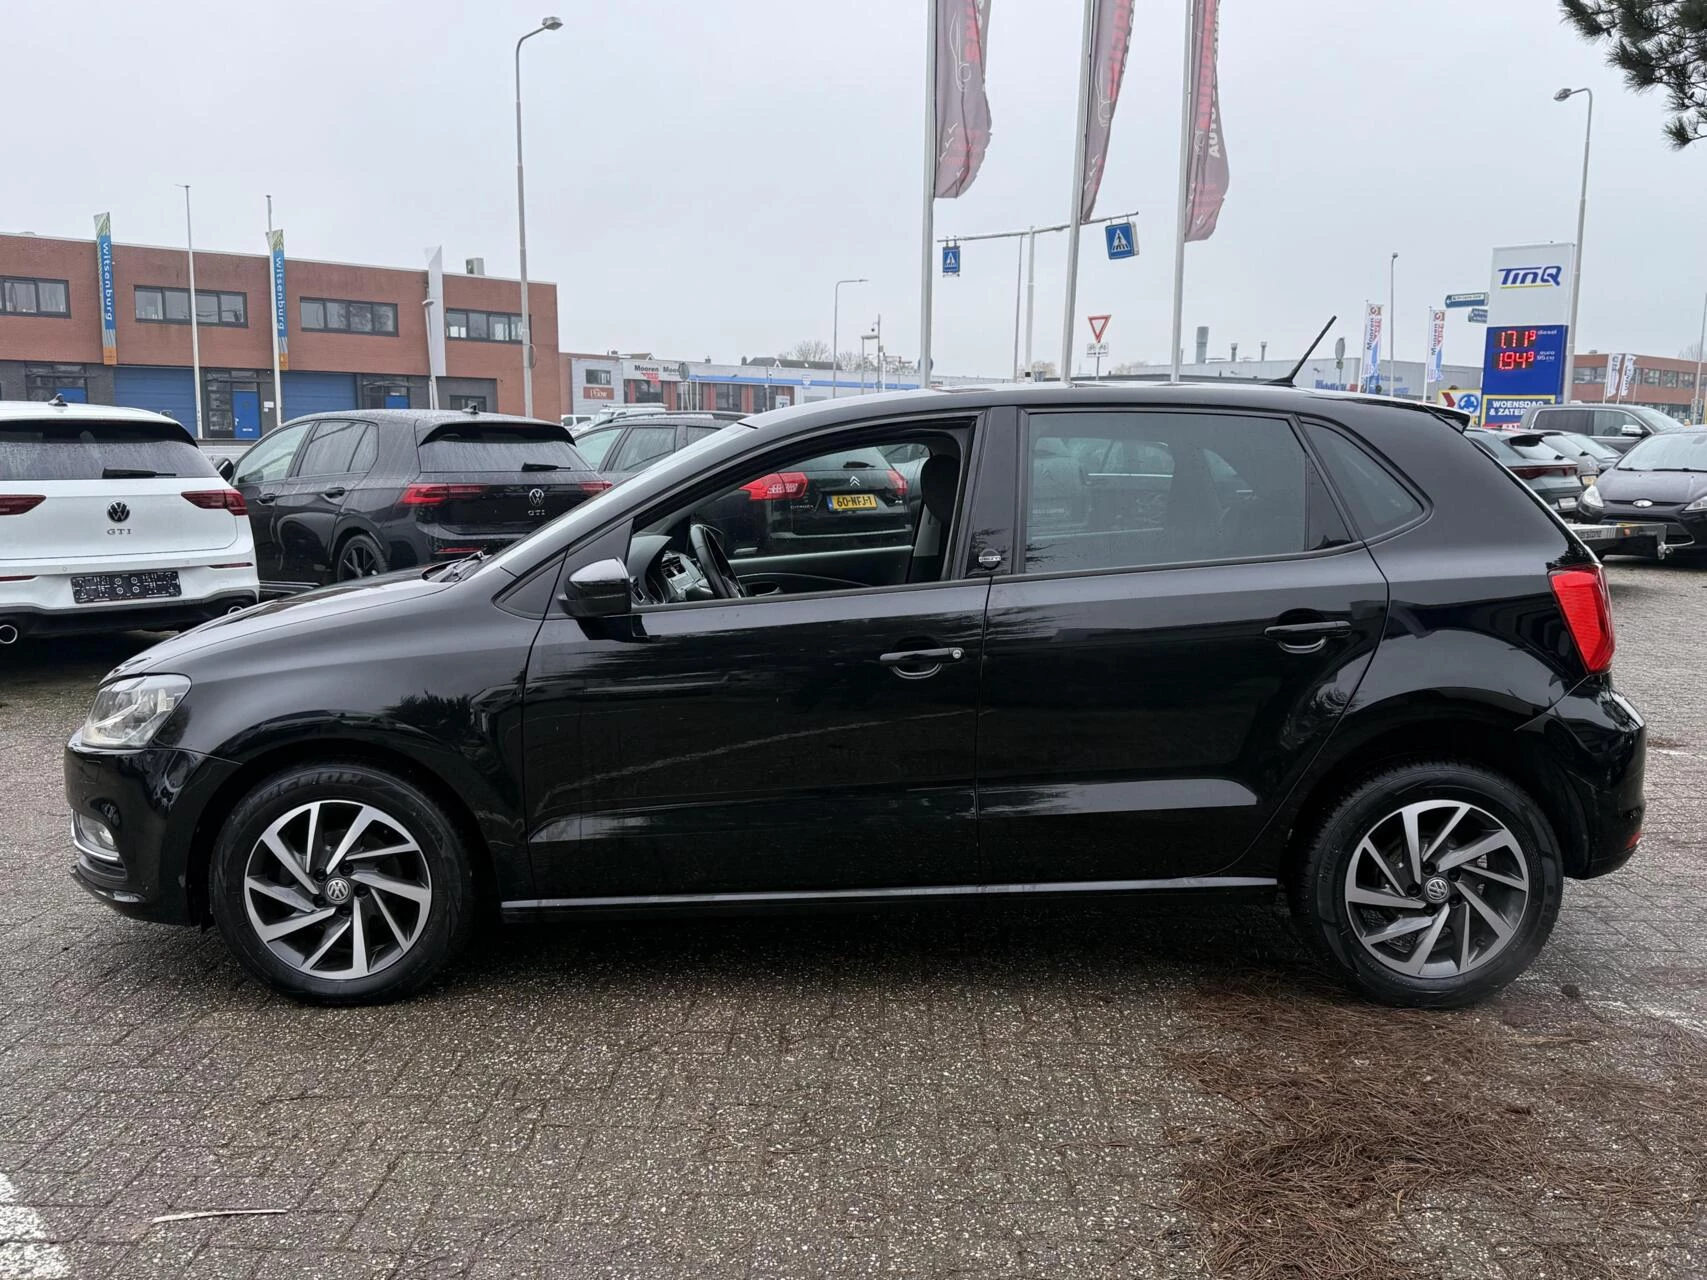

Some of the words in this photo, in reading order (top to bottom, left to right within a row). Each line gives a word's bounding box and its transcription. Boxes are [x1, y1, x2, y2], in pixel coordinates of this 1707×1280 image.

[102, 242, 113, 321] witsenburg
[275, 257, 285, 330] witsenburg
[1489, 408, 1496, 416] &
[836, 495, 873, 508] 60-NFJ-1
